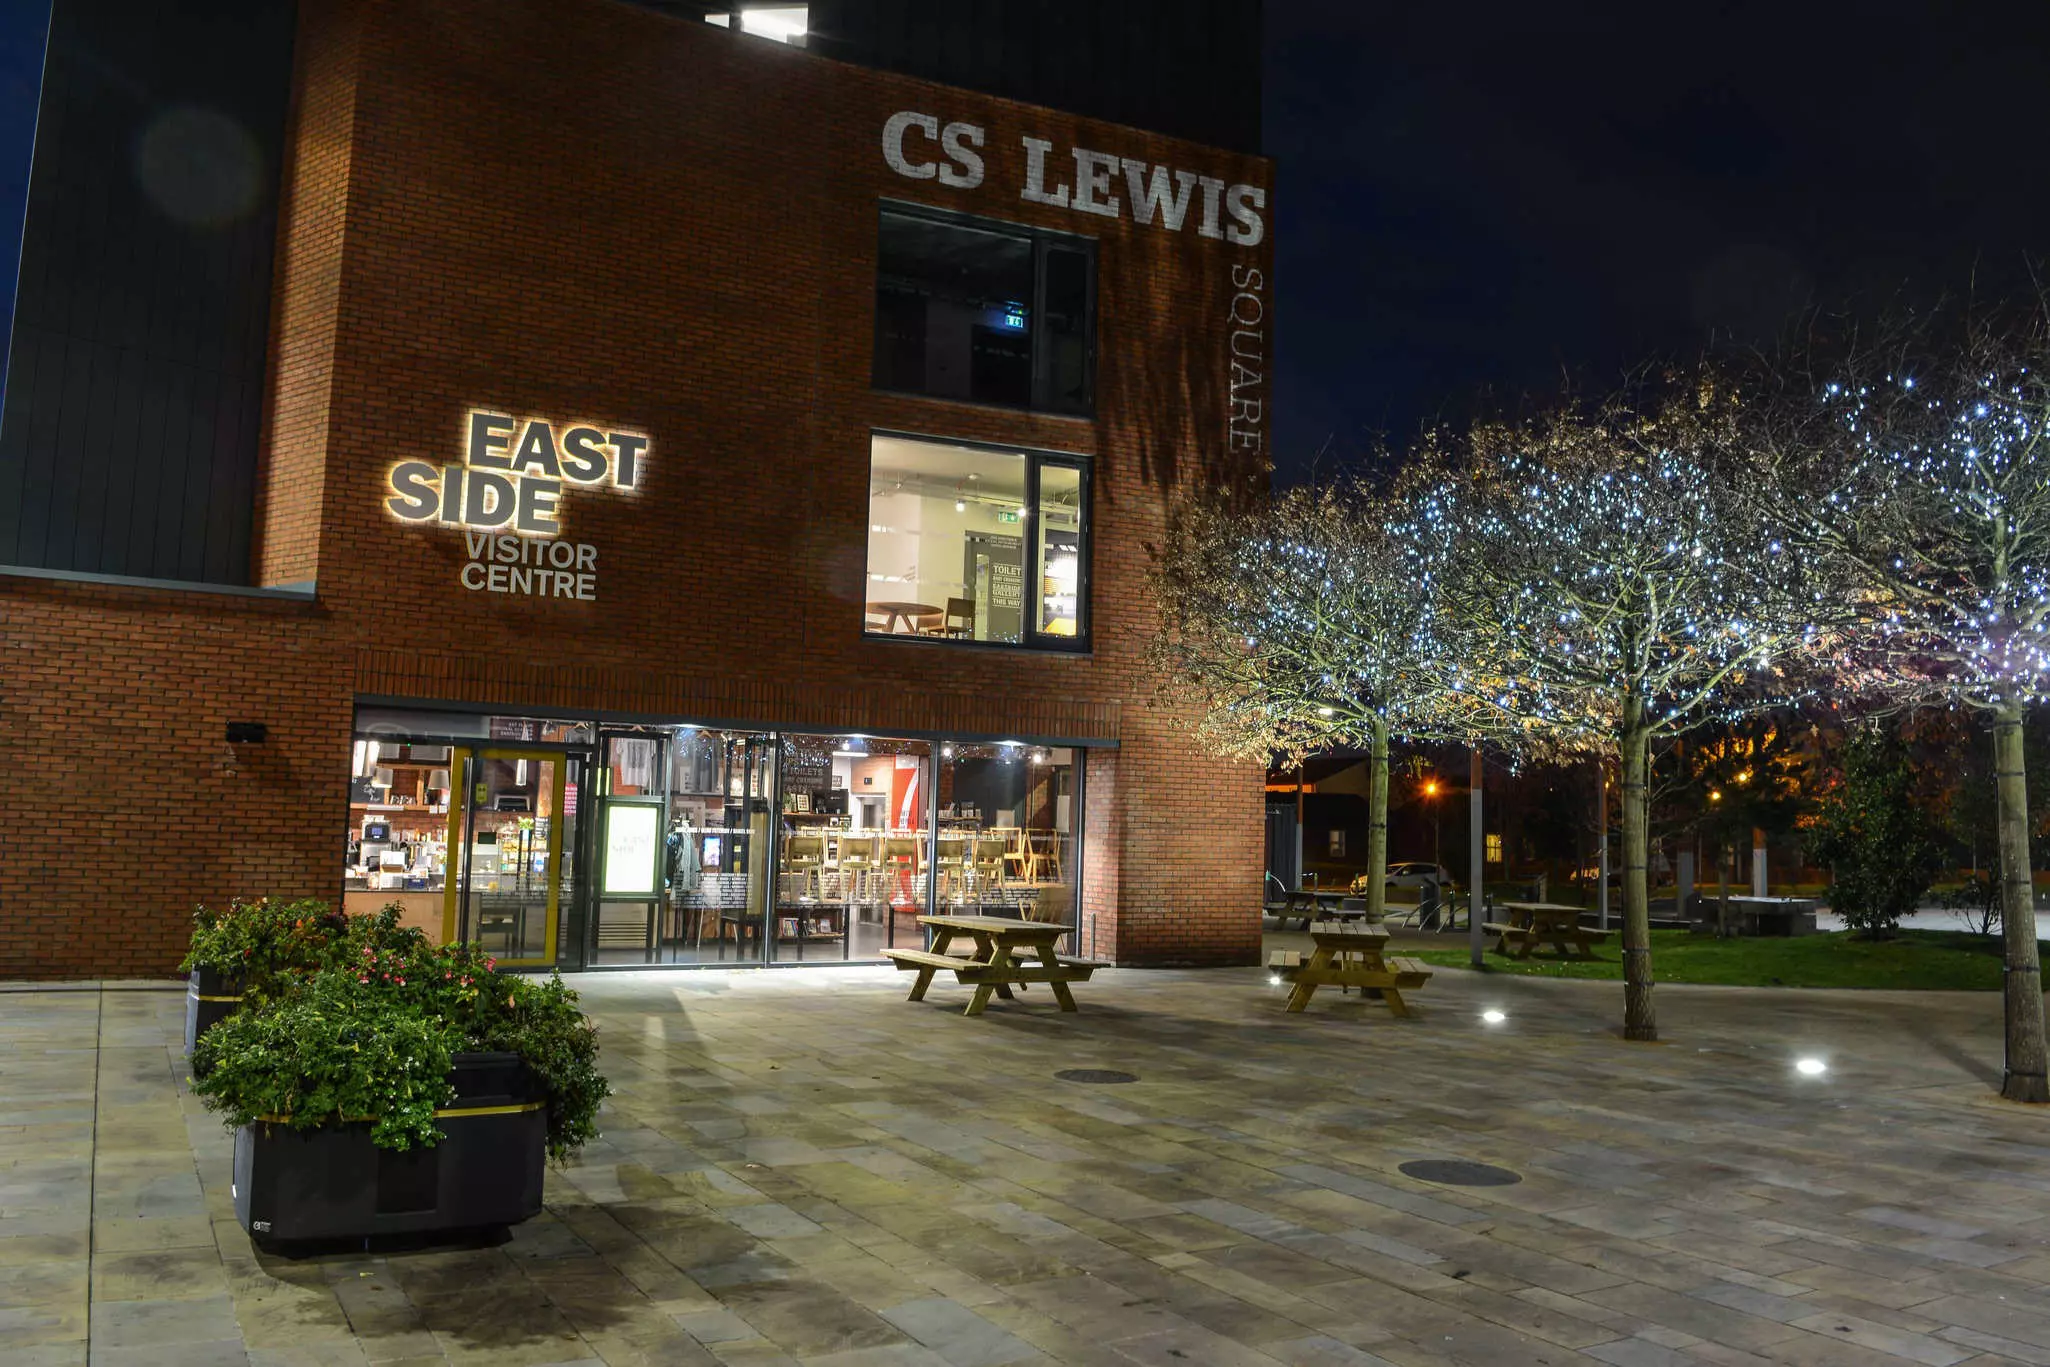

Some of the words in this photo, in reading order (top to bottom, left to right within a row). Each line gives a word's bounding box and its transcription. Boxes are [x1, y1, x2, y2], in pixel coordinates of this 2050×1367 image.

[881, 111, 985, 190] CS
[1020, 135, 1266, 247] LEWIS
[1227, 264, 1263, 456] SQUARE
[468, 413, 648, 488] EAST
[387, 462, 562, 533] SIDE
[461, 563, 597, 600] CENTRE
[464, 532, 598, 571] VISITOR
